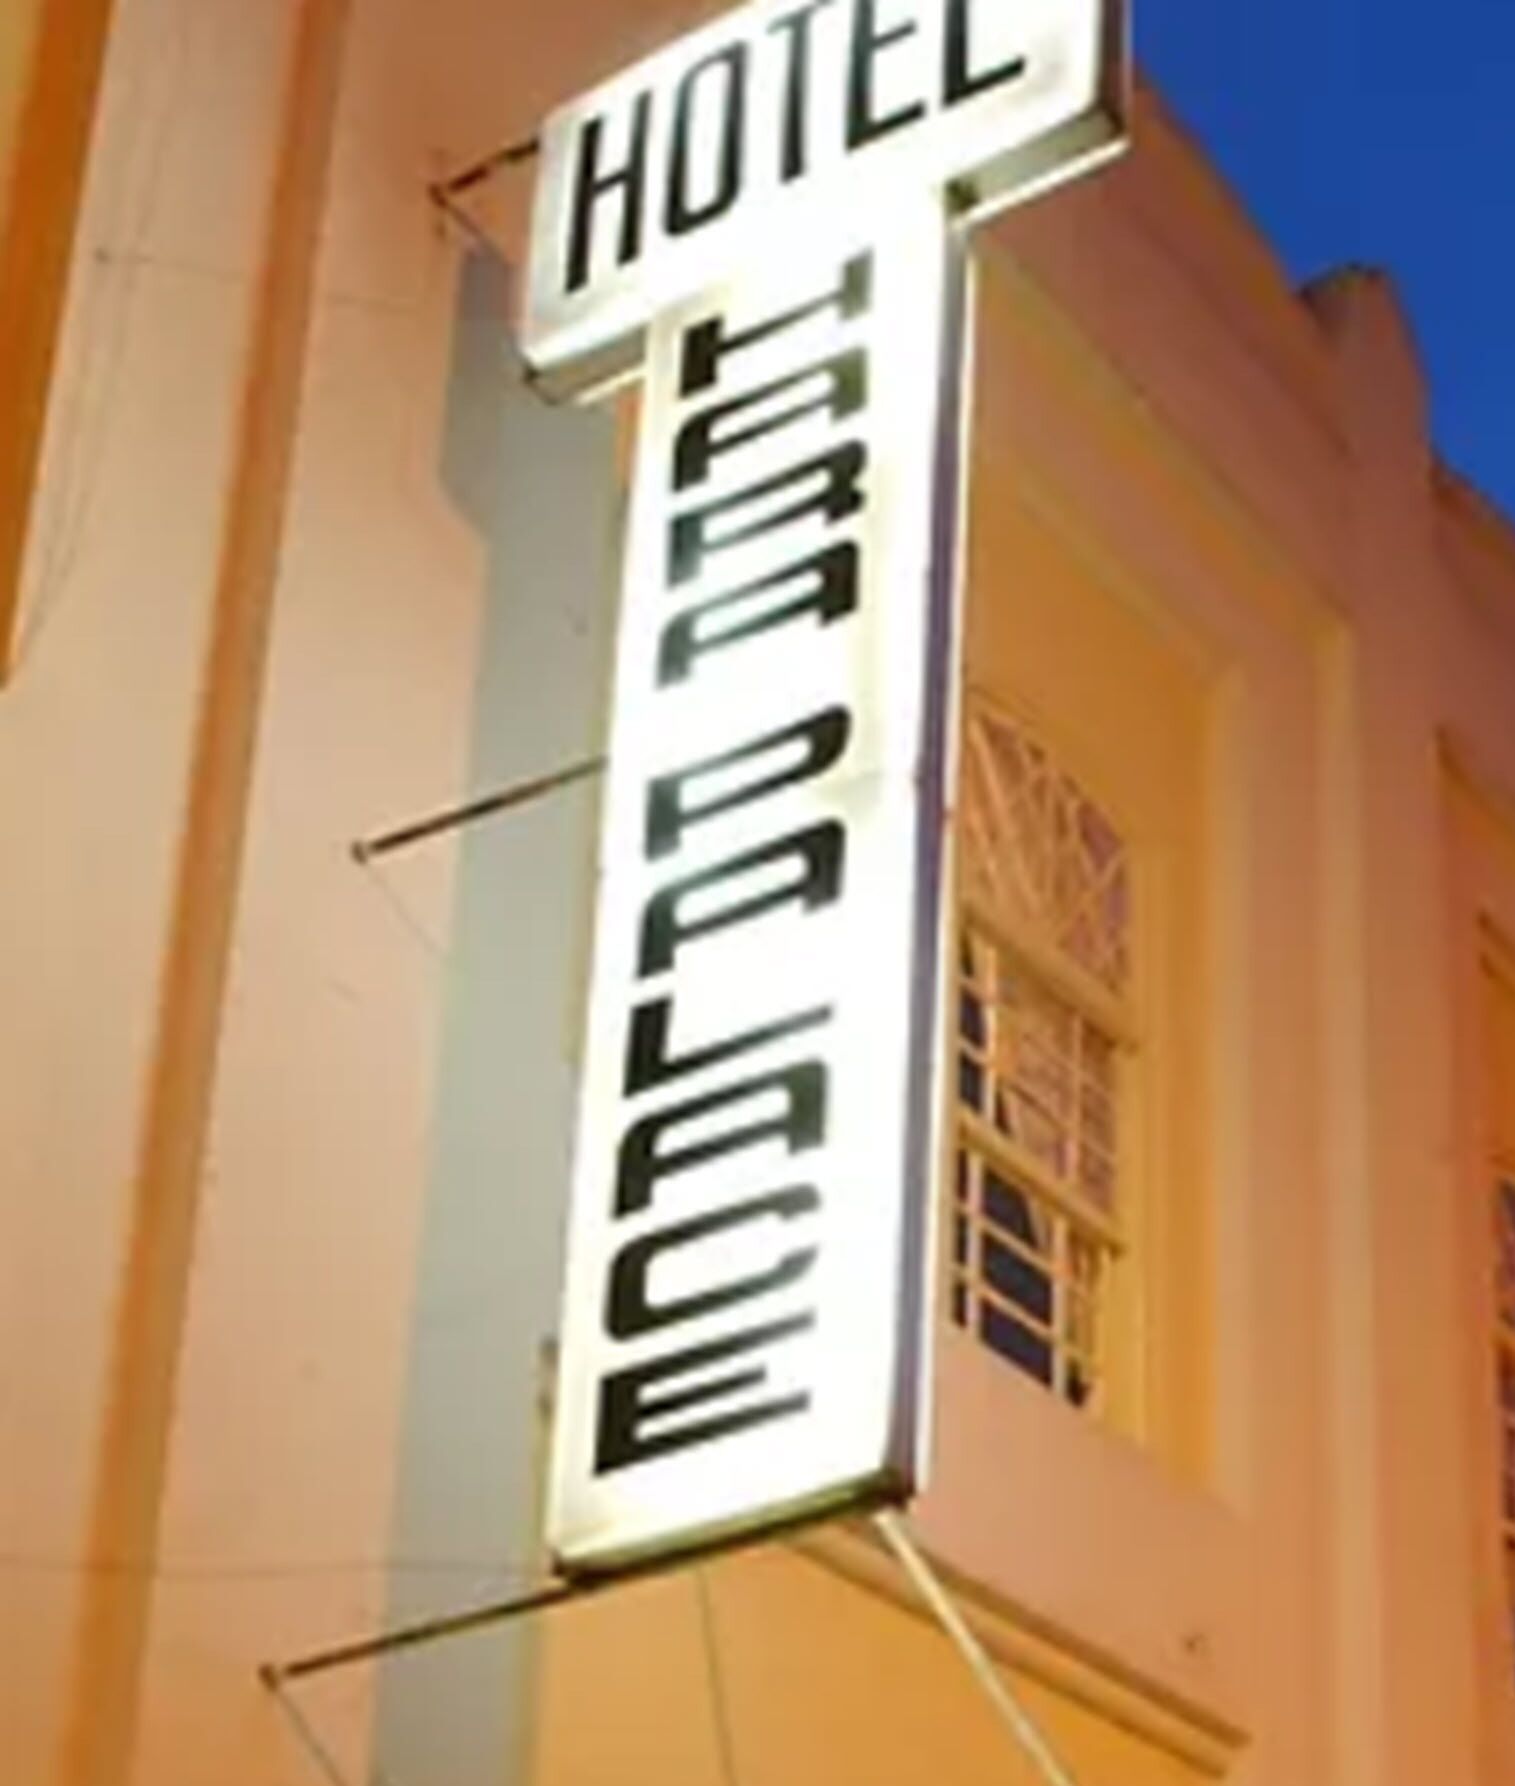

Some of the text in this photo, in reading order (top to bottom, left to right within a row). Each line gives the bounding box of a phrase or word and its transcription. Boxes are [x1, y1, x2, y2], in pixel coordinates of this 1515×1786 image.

[564, 0, 1026, 294] HOTEL
[593, 248, 872, 1478] HARA PALACE
